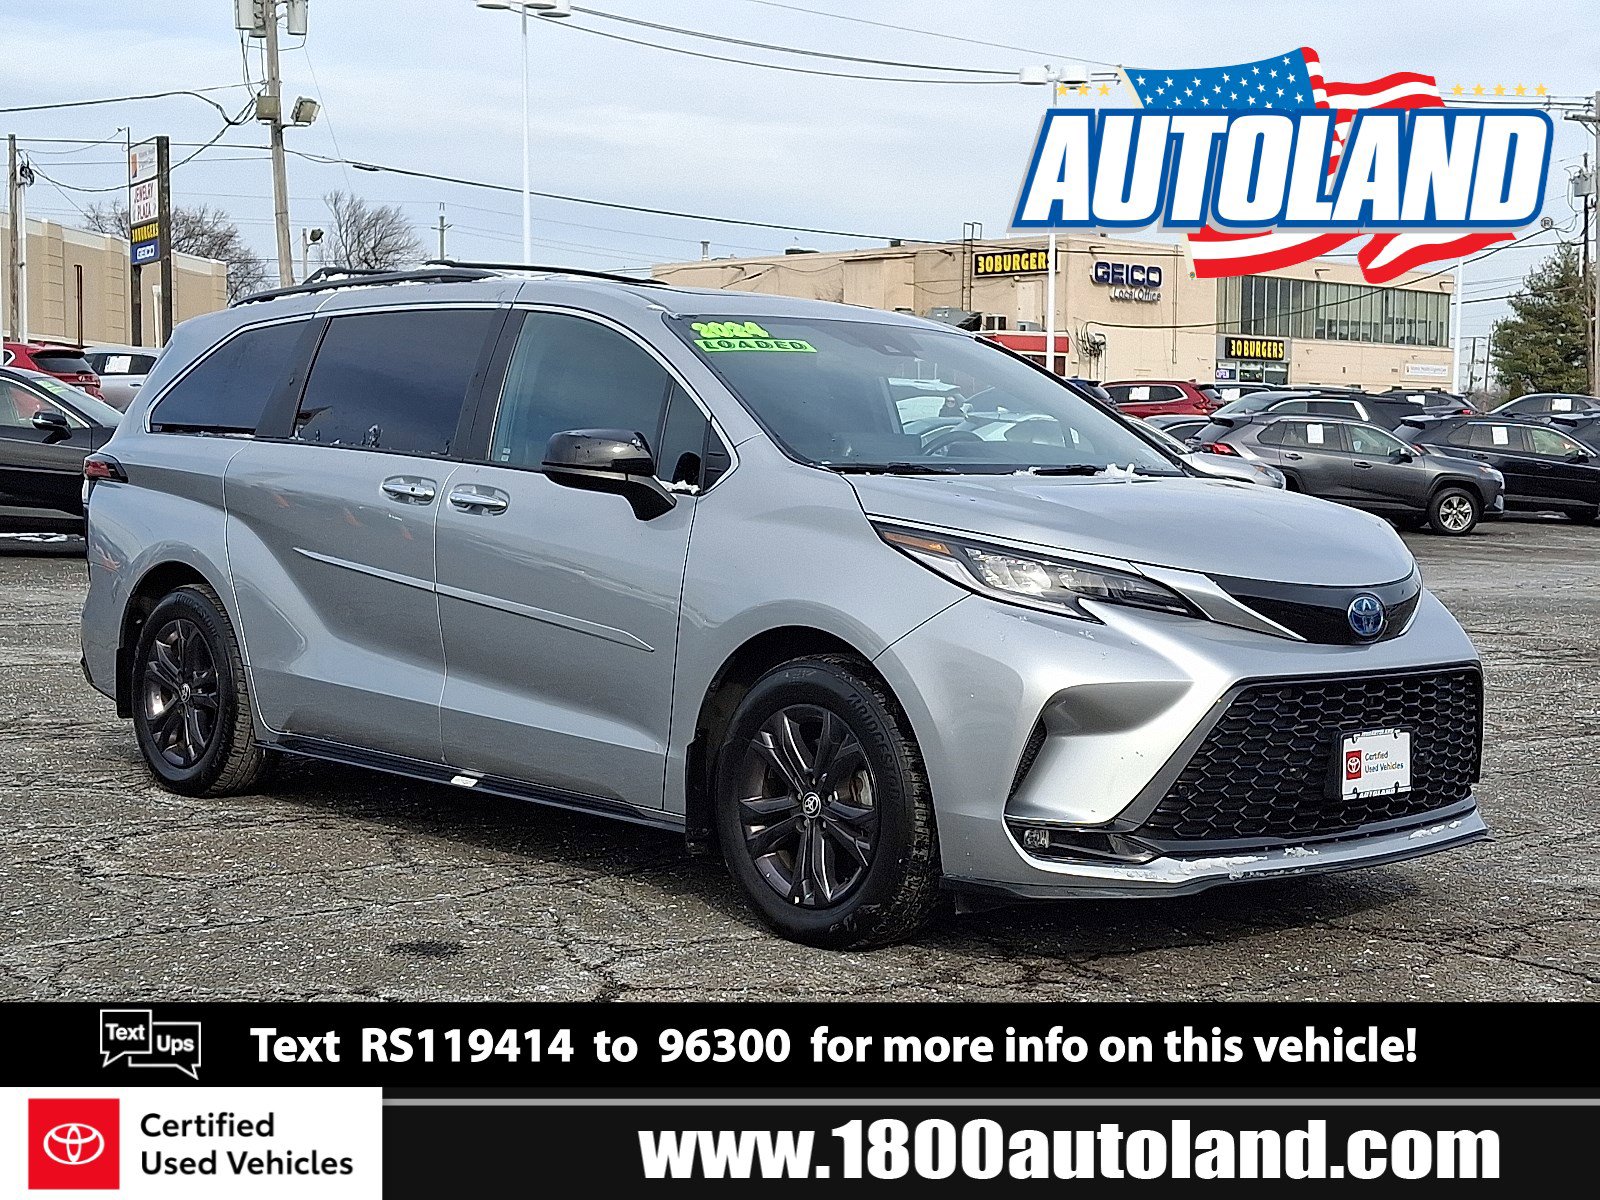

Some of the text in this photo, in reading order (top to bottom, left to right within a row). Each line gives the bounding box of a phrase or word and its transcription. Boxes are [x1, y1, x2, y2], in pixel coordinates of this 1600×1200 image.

[134, 182, 153, 203] JEWELRY
[137, 202, 151, 221] PLAZA
[1093, 261, 1163, 288] GEICO
[1113, 287, 1161, 301] Local Office
[691, 321, 769, 338] 2024
[703, 340, 807, 350] LOADED
[1364, 750, 1389, 761] Certified
[1364, 762, 1404, 773] Used Vehicles
